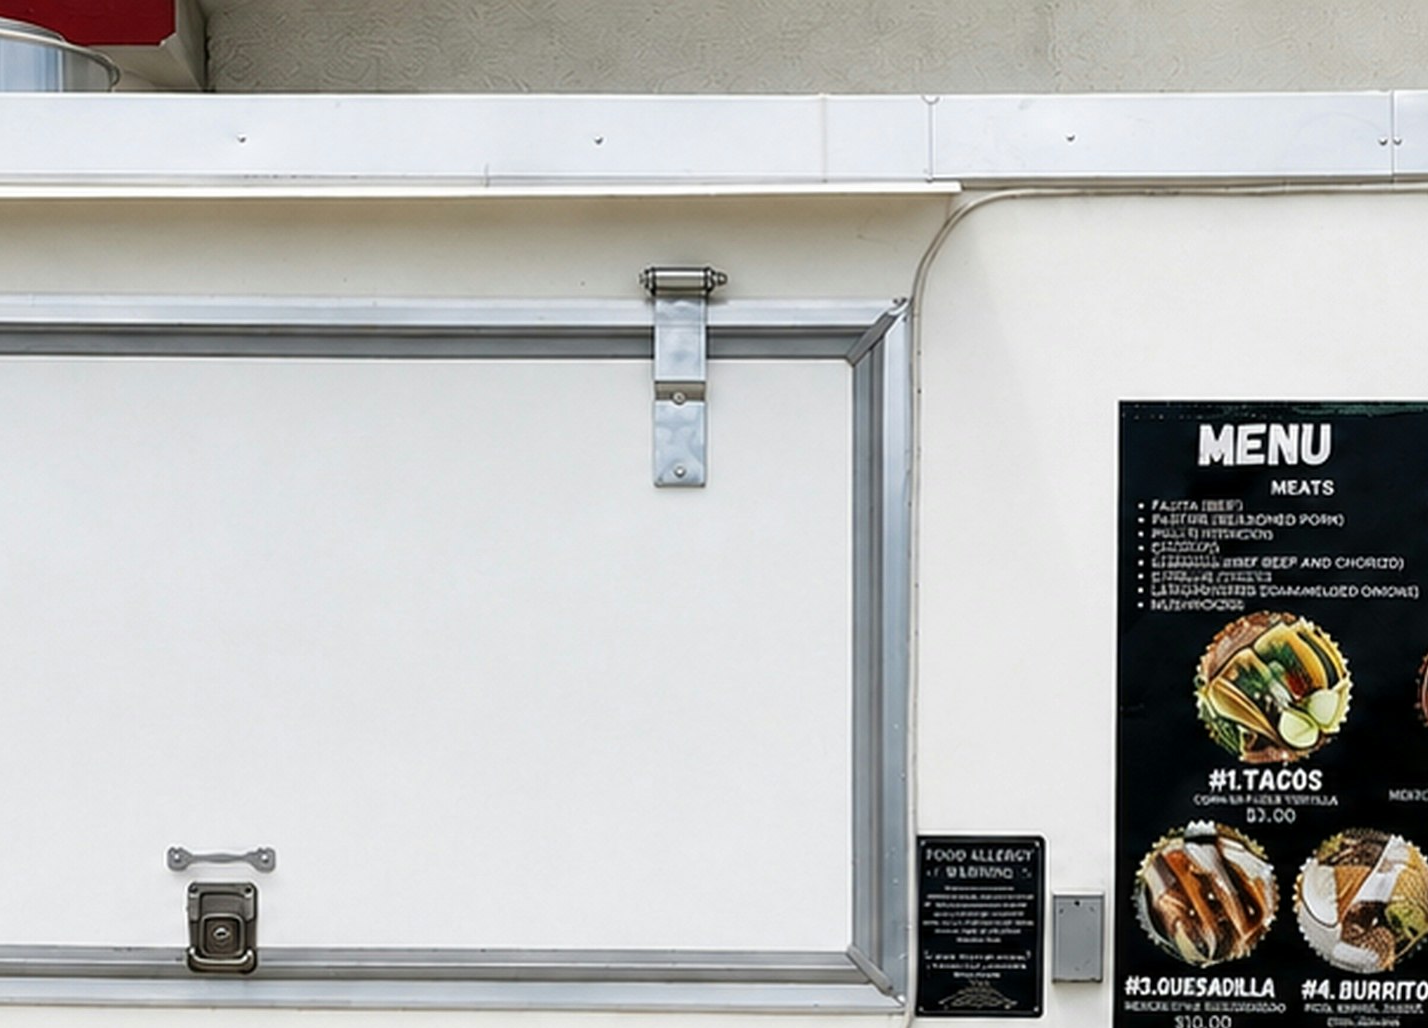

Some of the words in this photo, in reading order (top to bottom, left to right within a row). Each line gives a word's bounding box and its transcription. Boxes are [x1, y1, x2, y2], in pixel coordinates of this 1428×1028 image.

[1197, 423, 1332, 467] MENU
[1270, 480, 1335, 496] MEATS
[1300, 557, 1331, 568] AND
[1209, 769, 1323, 791] #1.TACOS
